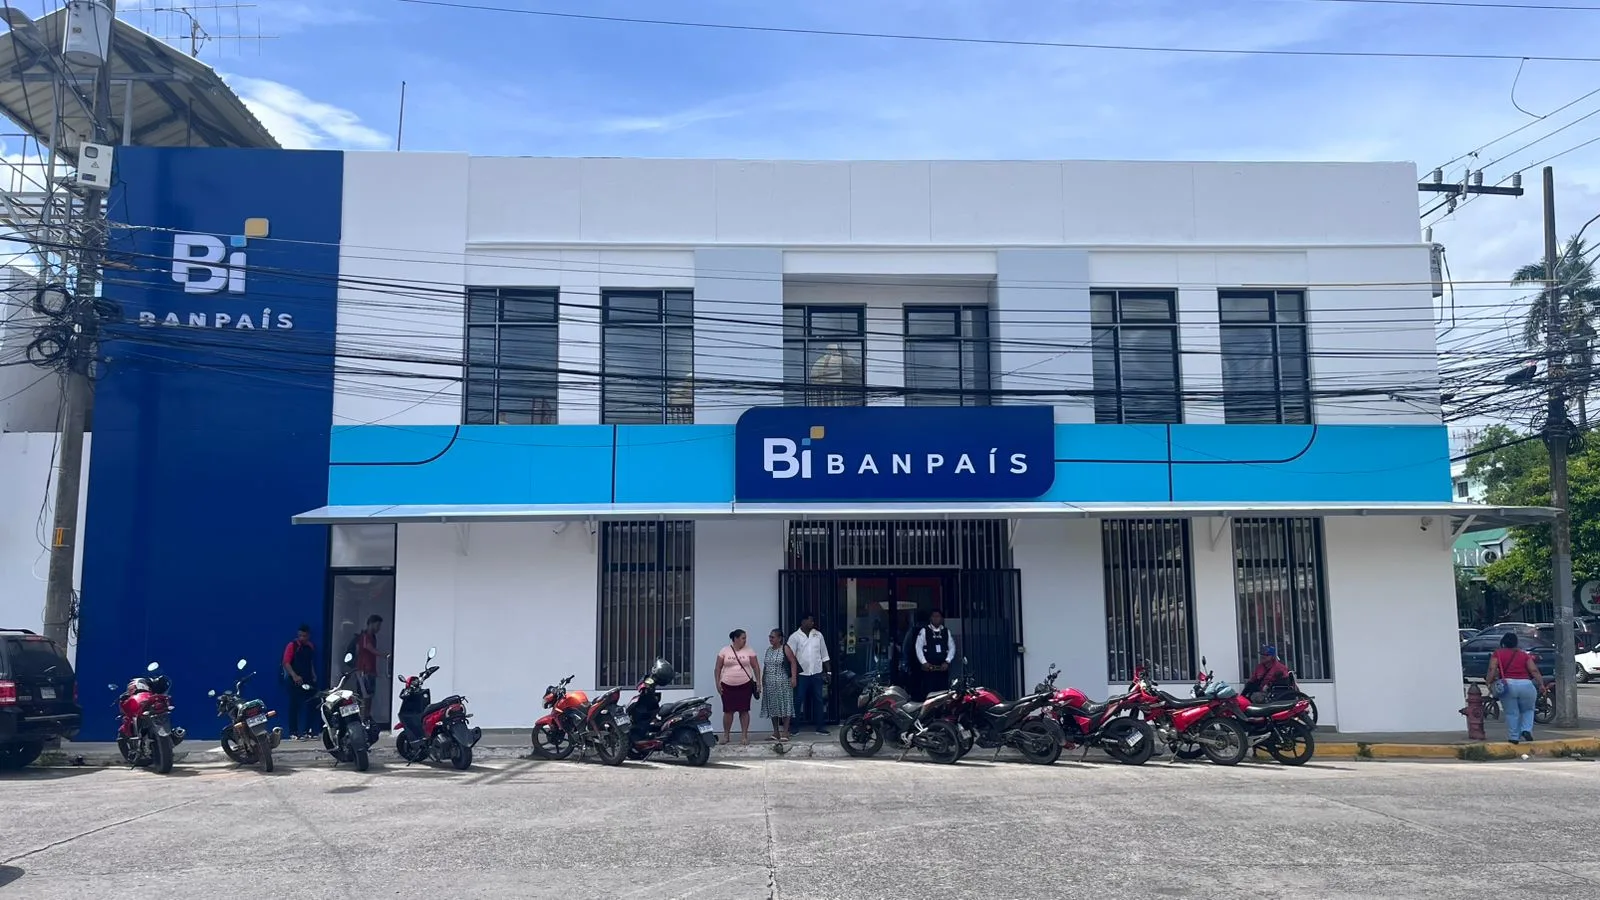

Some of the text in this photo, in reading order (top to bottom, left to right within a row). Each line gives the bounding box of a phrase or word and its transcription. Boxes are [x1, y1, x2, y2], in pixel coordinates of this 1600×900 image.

[172, 232, 249, 294] Bi
[139, 307, 294, 330] BANPAÍS
[763, 436, 1029, 478] Bi BANPAÍS
